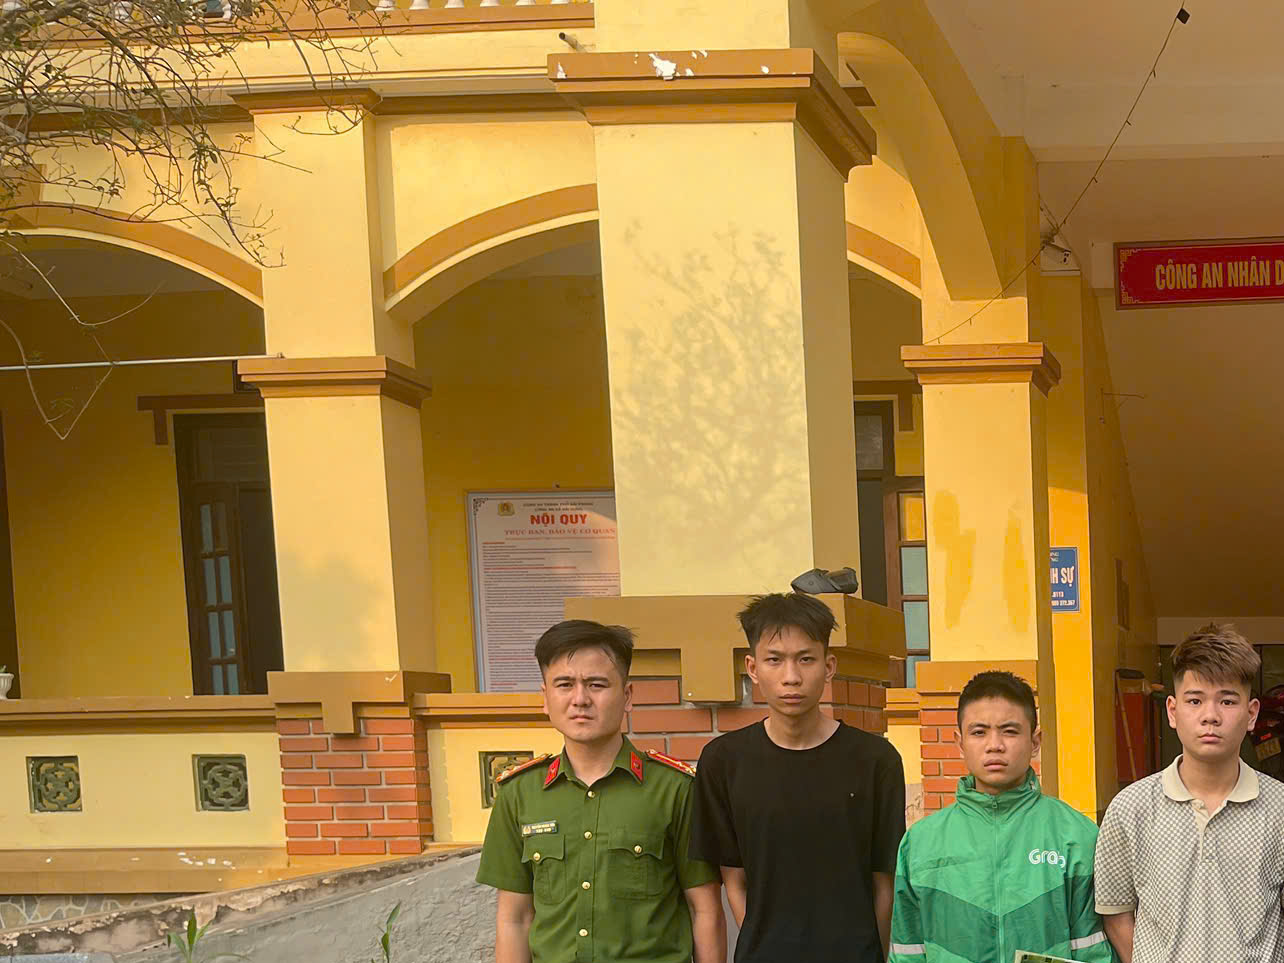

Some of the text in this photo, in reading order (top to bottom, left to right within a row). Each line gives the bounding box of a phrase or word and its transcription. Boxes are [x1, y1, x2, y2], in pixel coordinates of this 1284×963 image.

[1155, 258, 1197, 290] CÔNG
[1201, 262, 1224, 288] AN
[1227, 255, 1270, 287] NHÂN
[530, 512, 588, 527] NỘI QUY
[1060, 566, 1074, 587] SỰ
